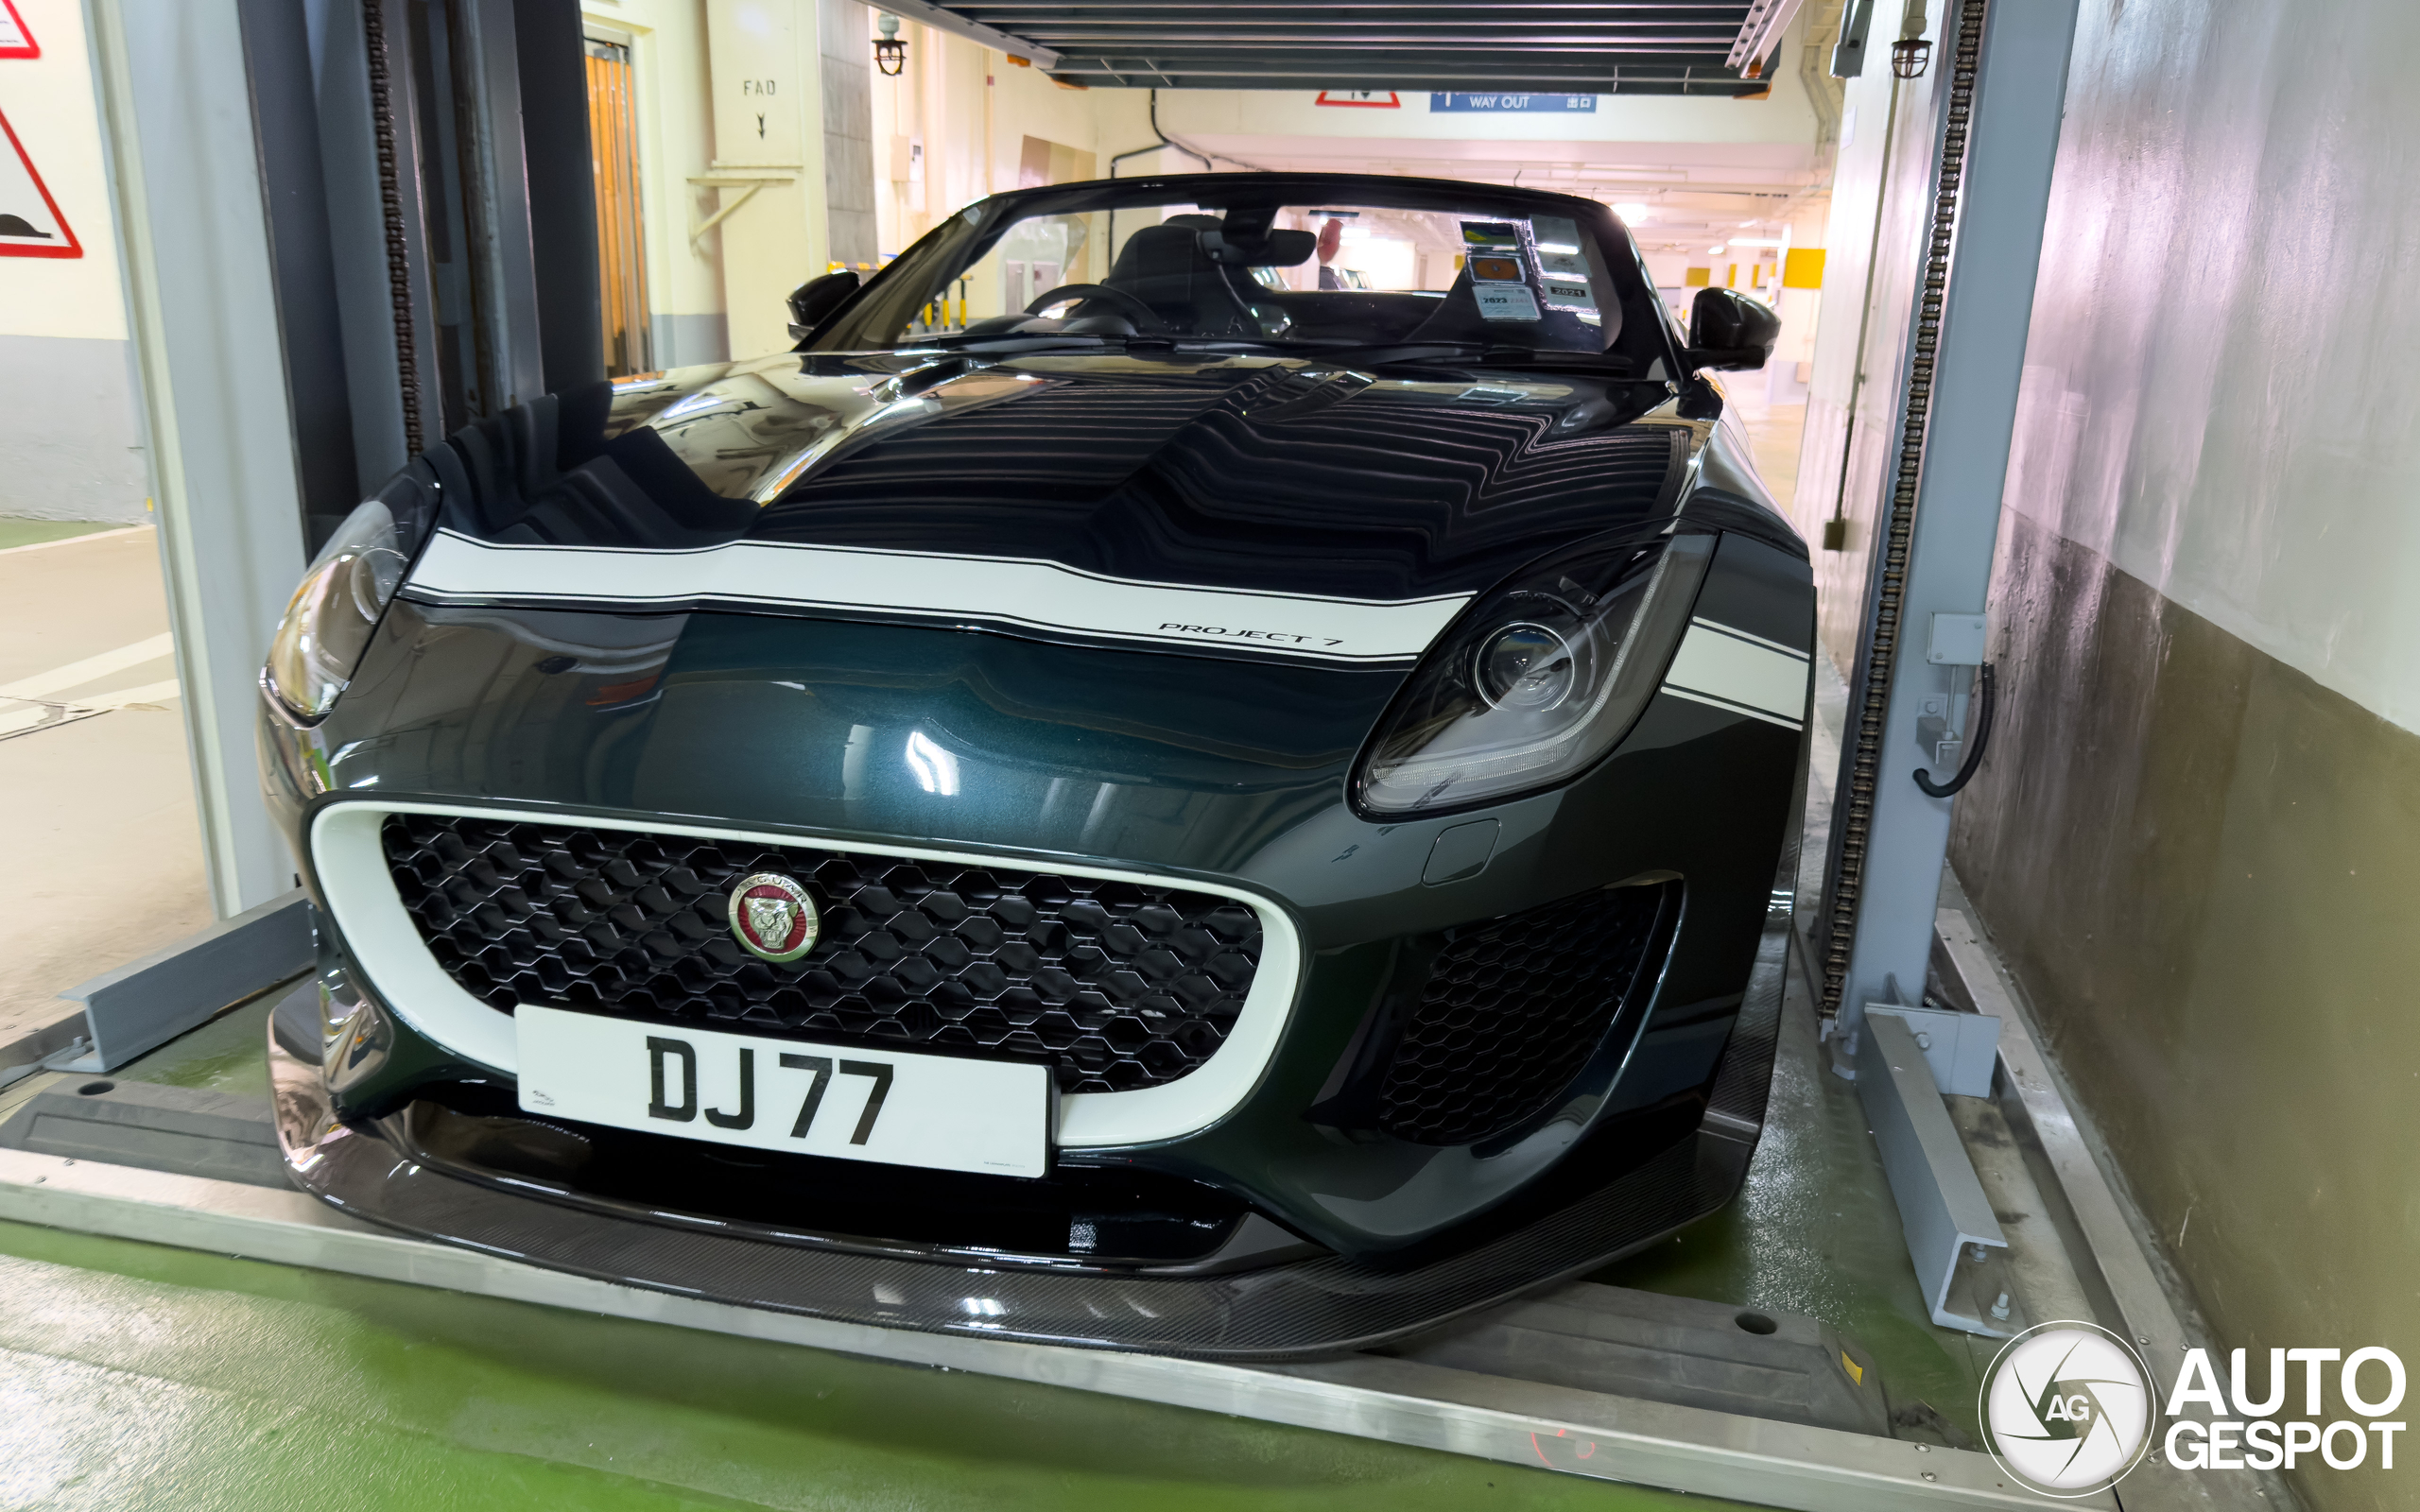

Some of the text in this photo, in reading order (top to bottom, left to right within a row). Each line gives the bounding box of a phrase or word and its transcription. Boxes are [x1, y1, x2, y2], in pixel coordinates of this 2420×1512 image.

[743, 79, 776, 95] FAD
[1469, 95, 1530, 109] WAY OUT
[1566, 96, 1592, 109] 出口
[1554, 288, 1582, 297] 2021
[1158, 623, 1344, 646] PROJECT 7
[736, 875, 807, 904] JAGUAR
[646, 1035, 894, 1146] DJ 77
